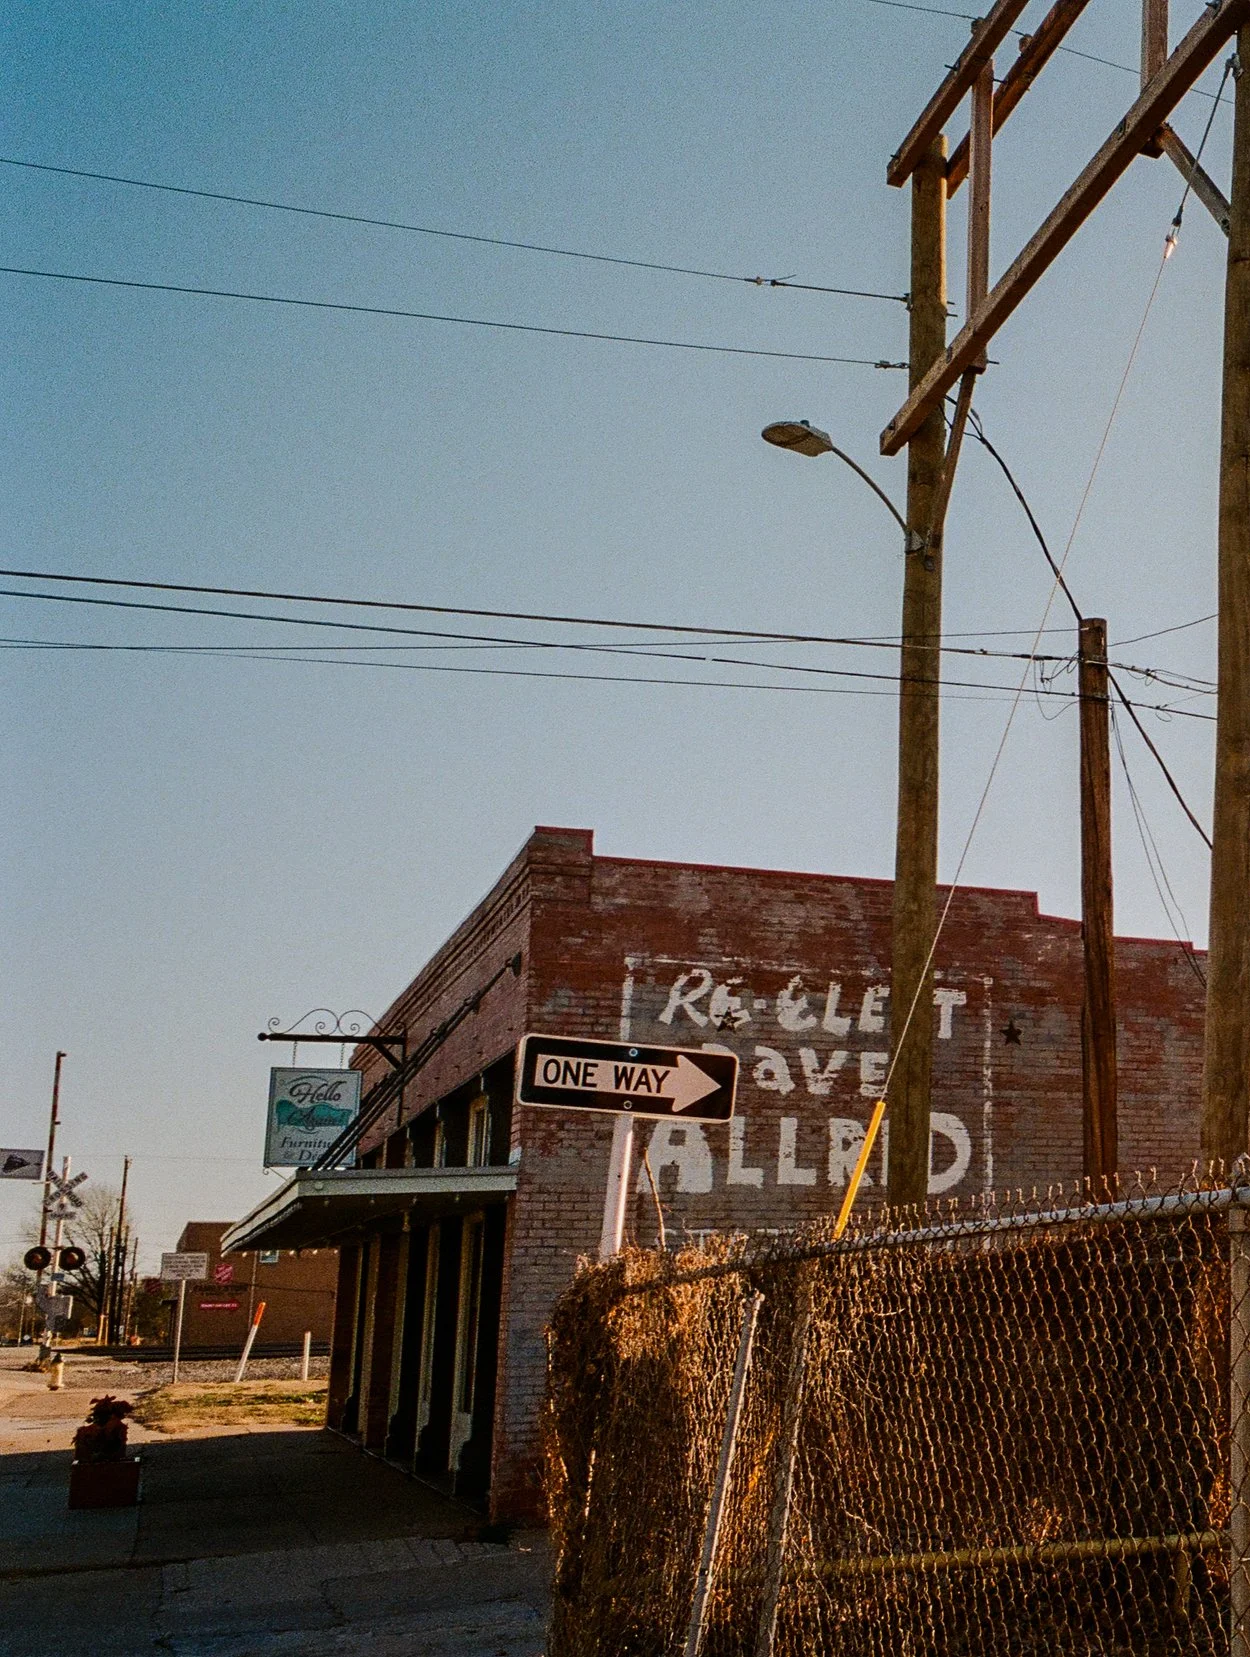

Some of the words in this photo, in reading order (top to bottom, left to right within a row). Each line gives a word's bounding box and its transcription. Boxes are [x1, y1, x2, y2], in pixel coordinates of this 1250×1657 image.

[542, 1058, 599, 1088] ONE
[613, 1064, 671, 1094] WAY
[289, 1080, 347, 1104] Hello
[280, 1136, 332, 1149] Furnitu
[635, 1111, 972, 1195] ALLRD
